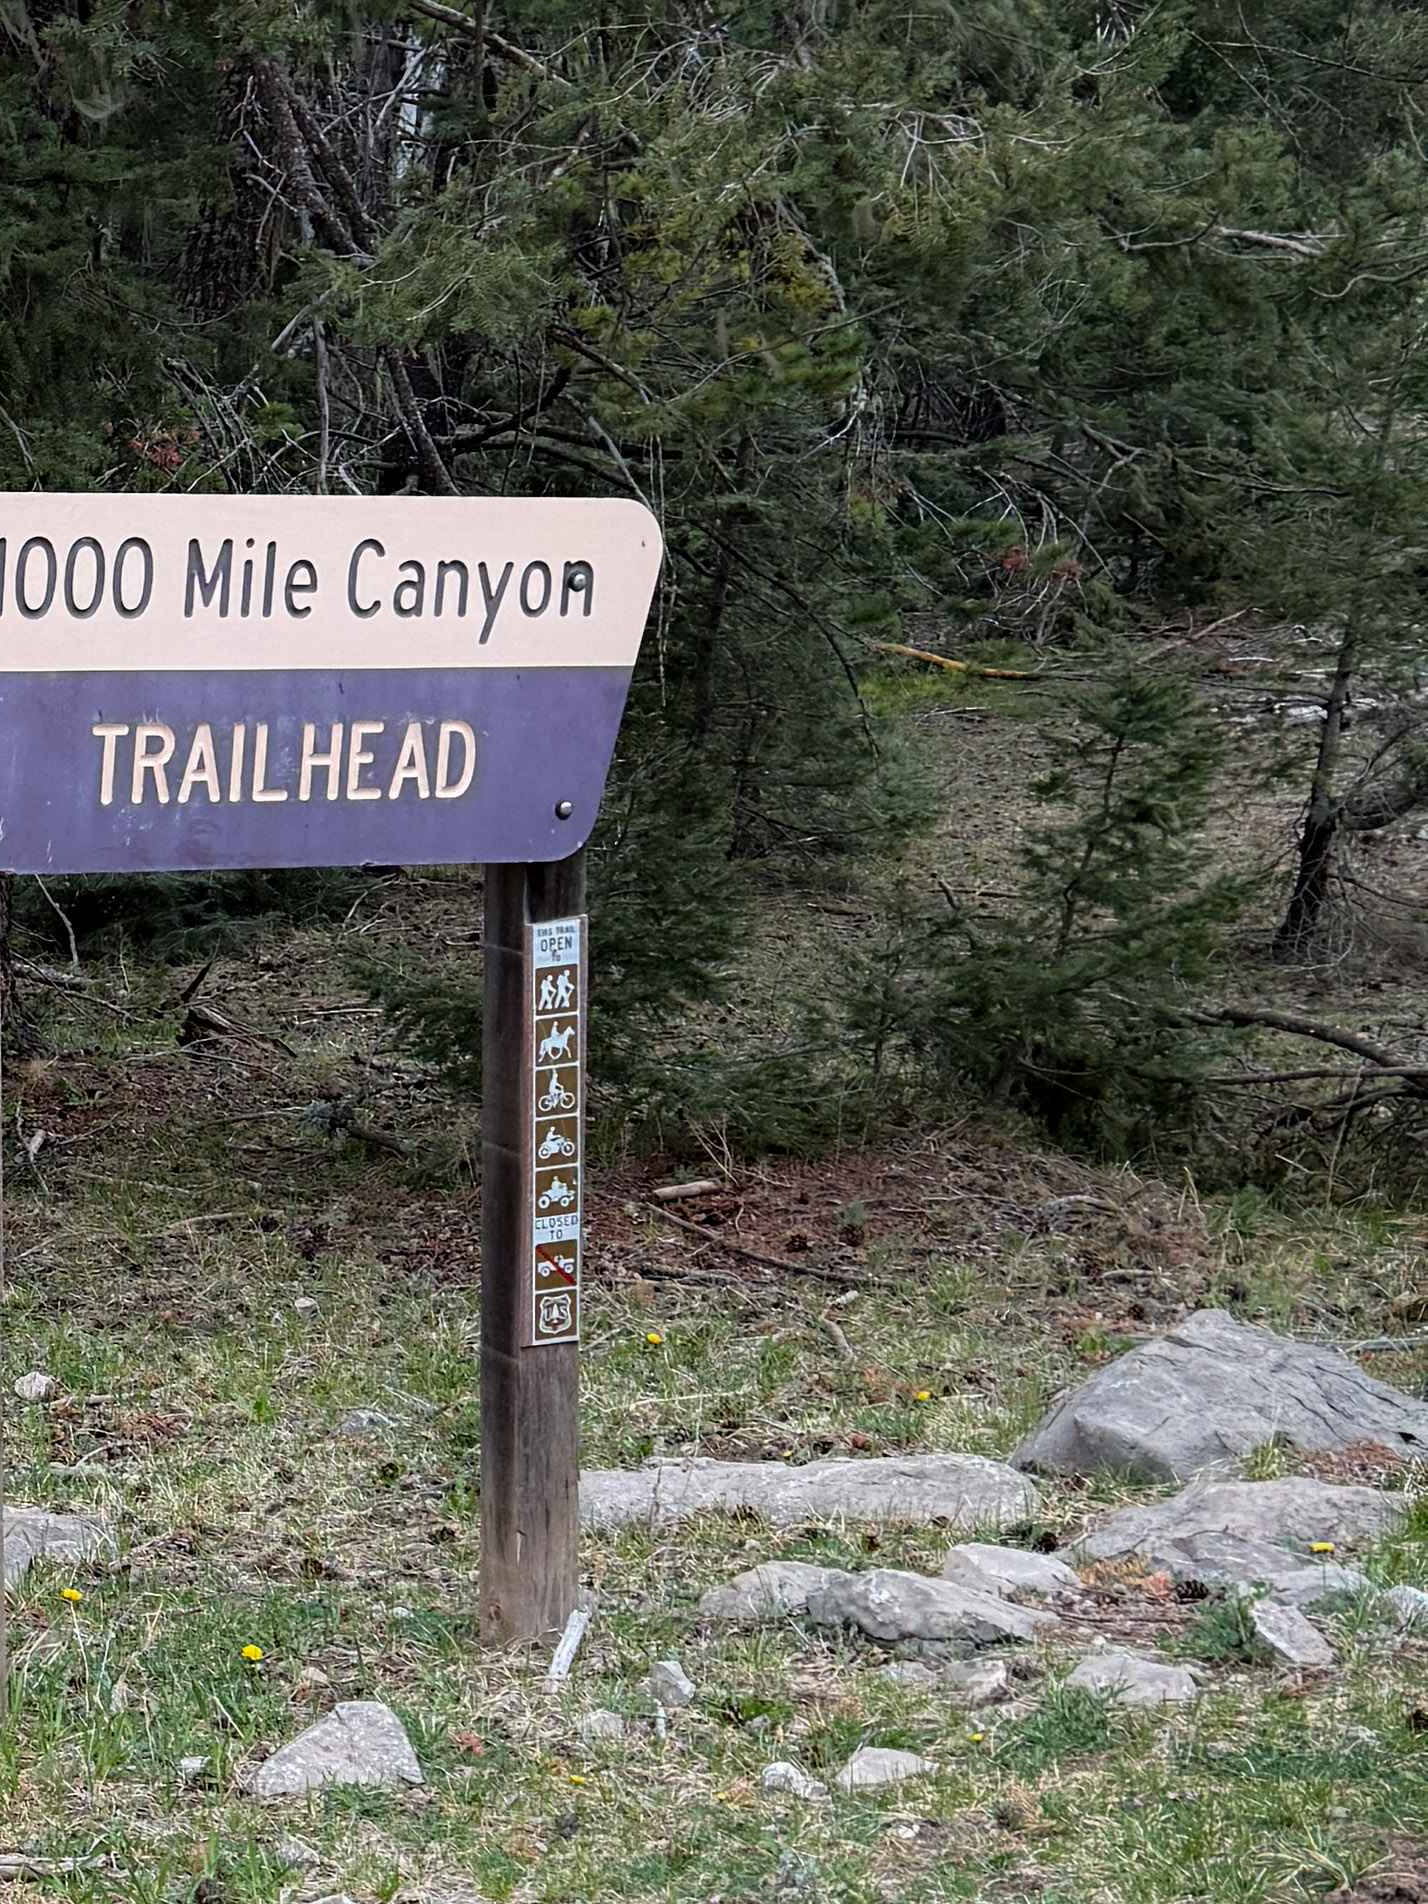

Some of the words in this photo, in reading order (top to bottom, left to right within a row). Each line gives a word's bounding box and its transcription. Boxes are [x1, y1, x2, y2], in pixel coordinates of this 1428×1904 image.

[183, 537, 319, 619] Mile
[347, 537, 595, 644] Canyon
[92, 719, 478, 804] TRAILHEAD
[540, 936, 573, 952] OPEN
[535, 1215, 579, 1230] CLOSED
[550, 1229, 563, 1240] TO
